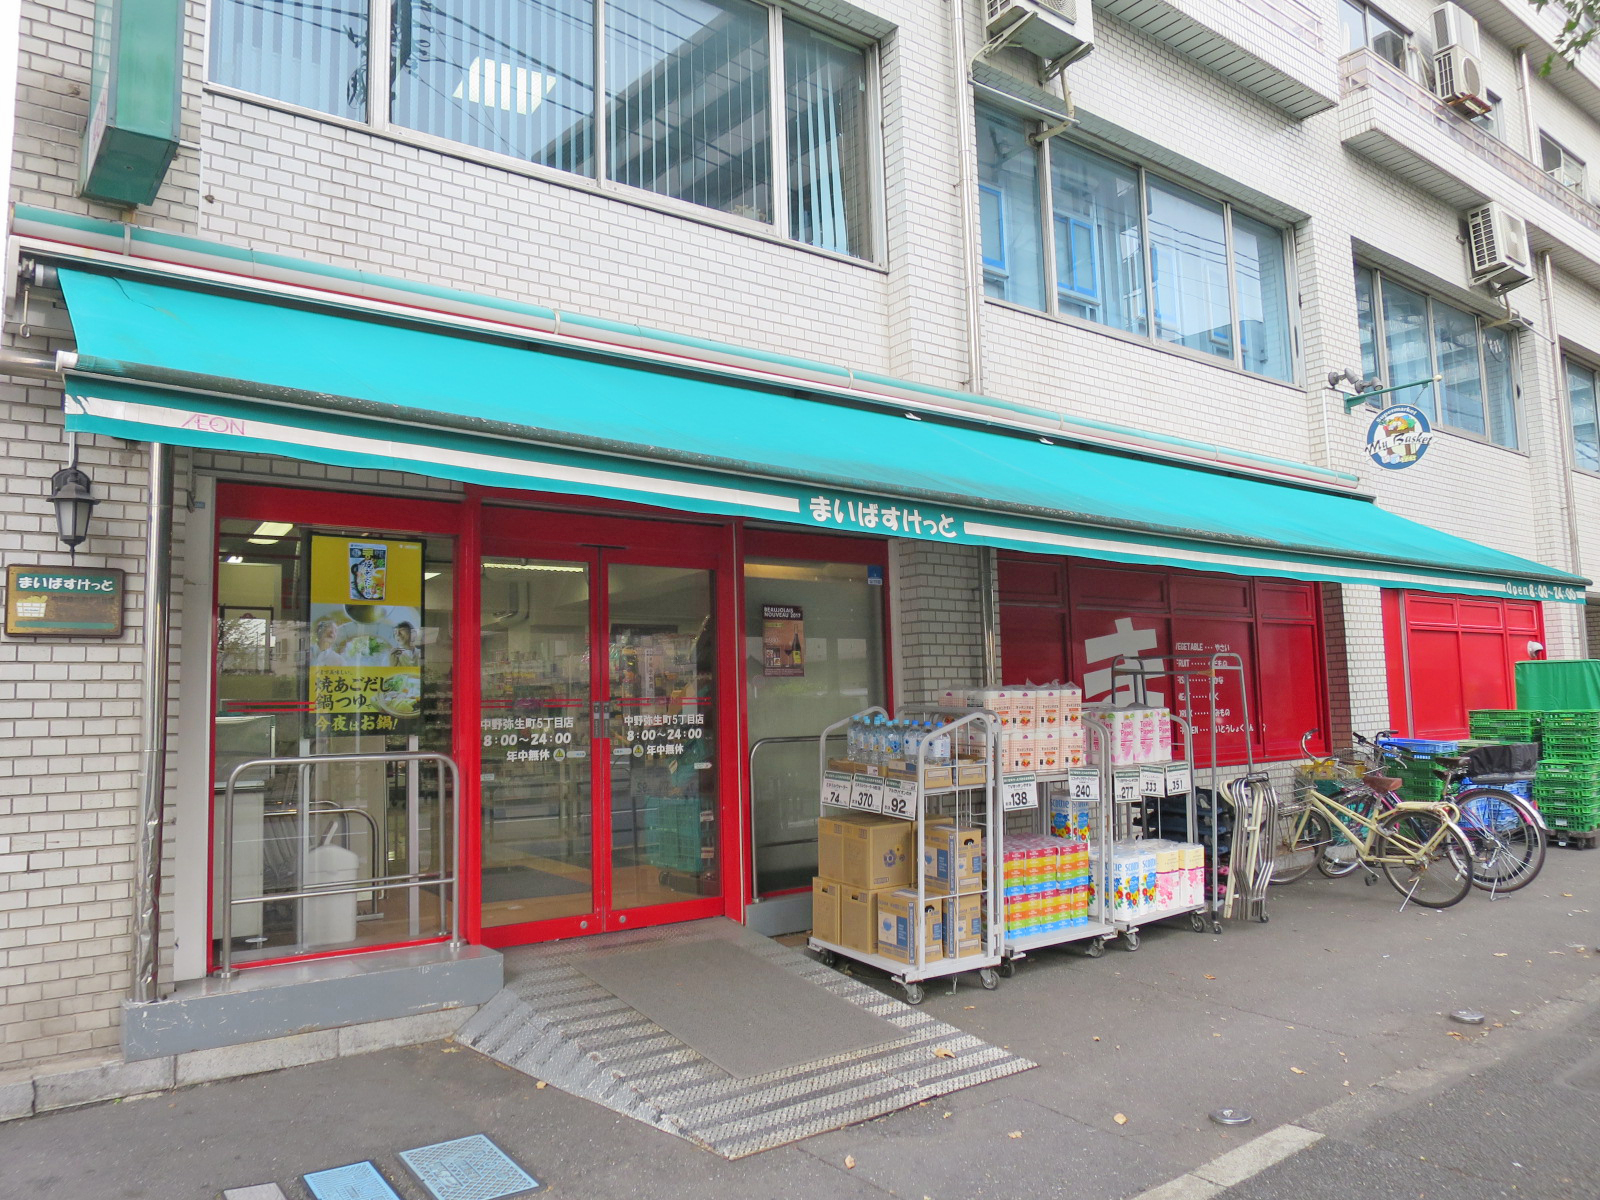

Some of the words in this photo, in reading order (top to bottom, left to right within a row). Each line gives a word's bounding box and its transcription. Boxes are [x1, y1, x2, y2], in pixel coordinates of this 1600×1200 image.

[809, 495, 957, 538] まいばすけっと
[18, 576, 114, 592] まいばすけっと
[1506, 581, 1529, 596] Open
[315, 676, 391, 694] 焼あごだし
[1179, 709, 1193, 717] RIK
[480, 716, 574, 731] 中野弥生町5丁目店
[624, 714, 705, 727] 中野弥生町5丁目店
[506, 749, 550, 763] 年中無休
[647, 744, 684, 755] 年中無休
[1075, 784, 1091, 798] 240
[1145, 781, 1157, 793] 333
[1172, 779, 1183, 791] 351
[830, 791, 840, 804] 74
[857, 791, 873, 808] 370
[1010, 791, 1028, 807] 138
[1121, 786, 1134, 799] 277
[891, 797, 907, 814] 92
